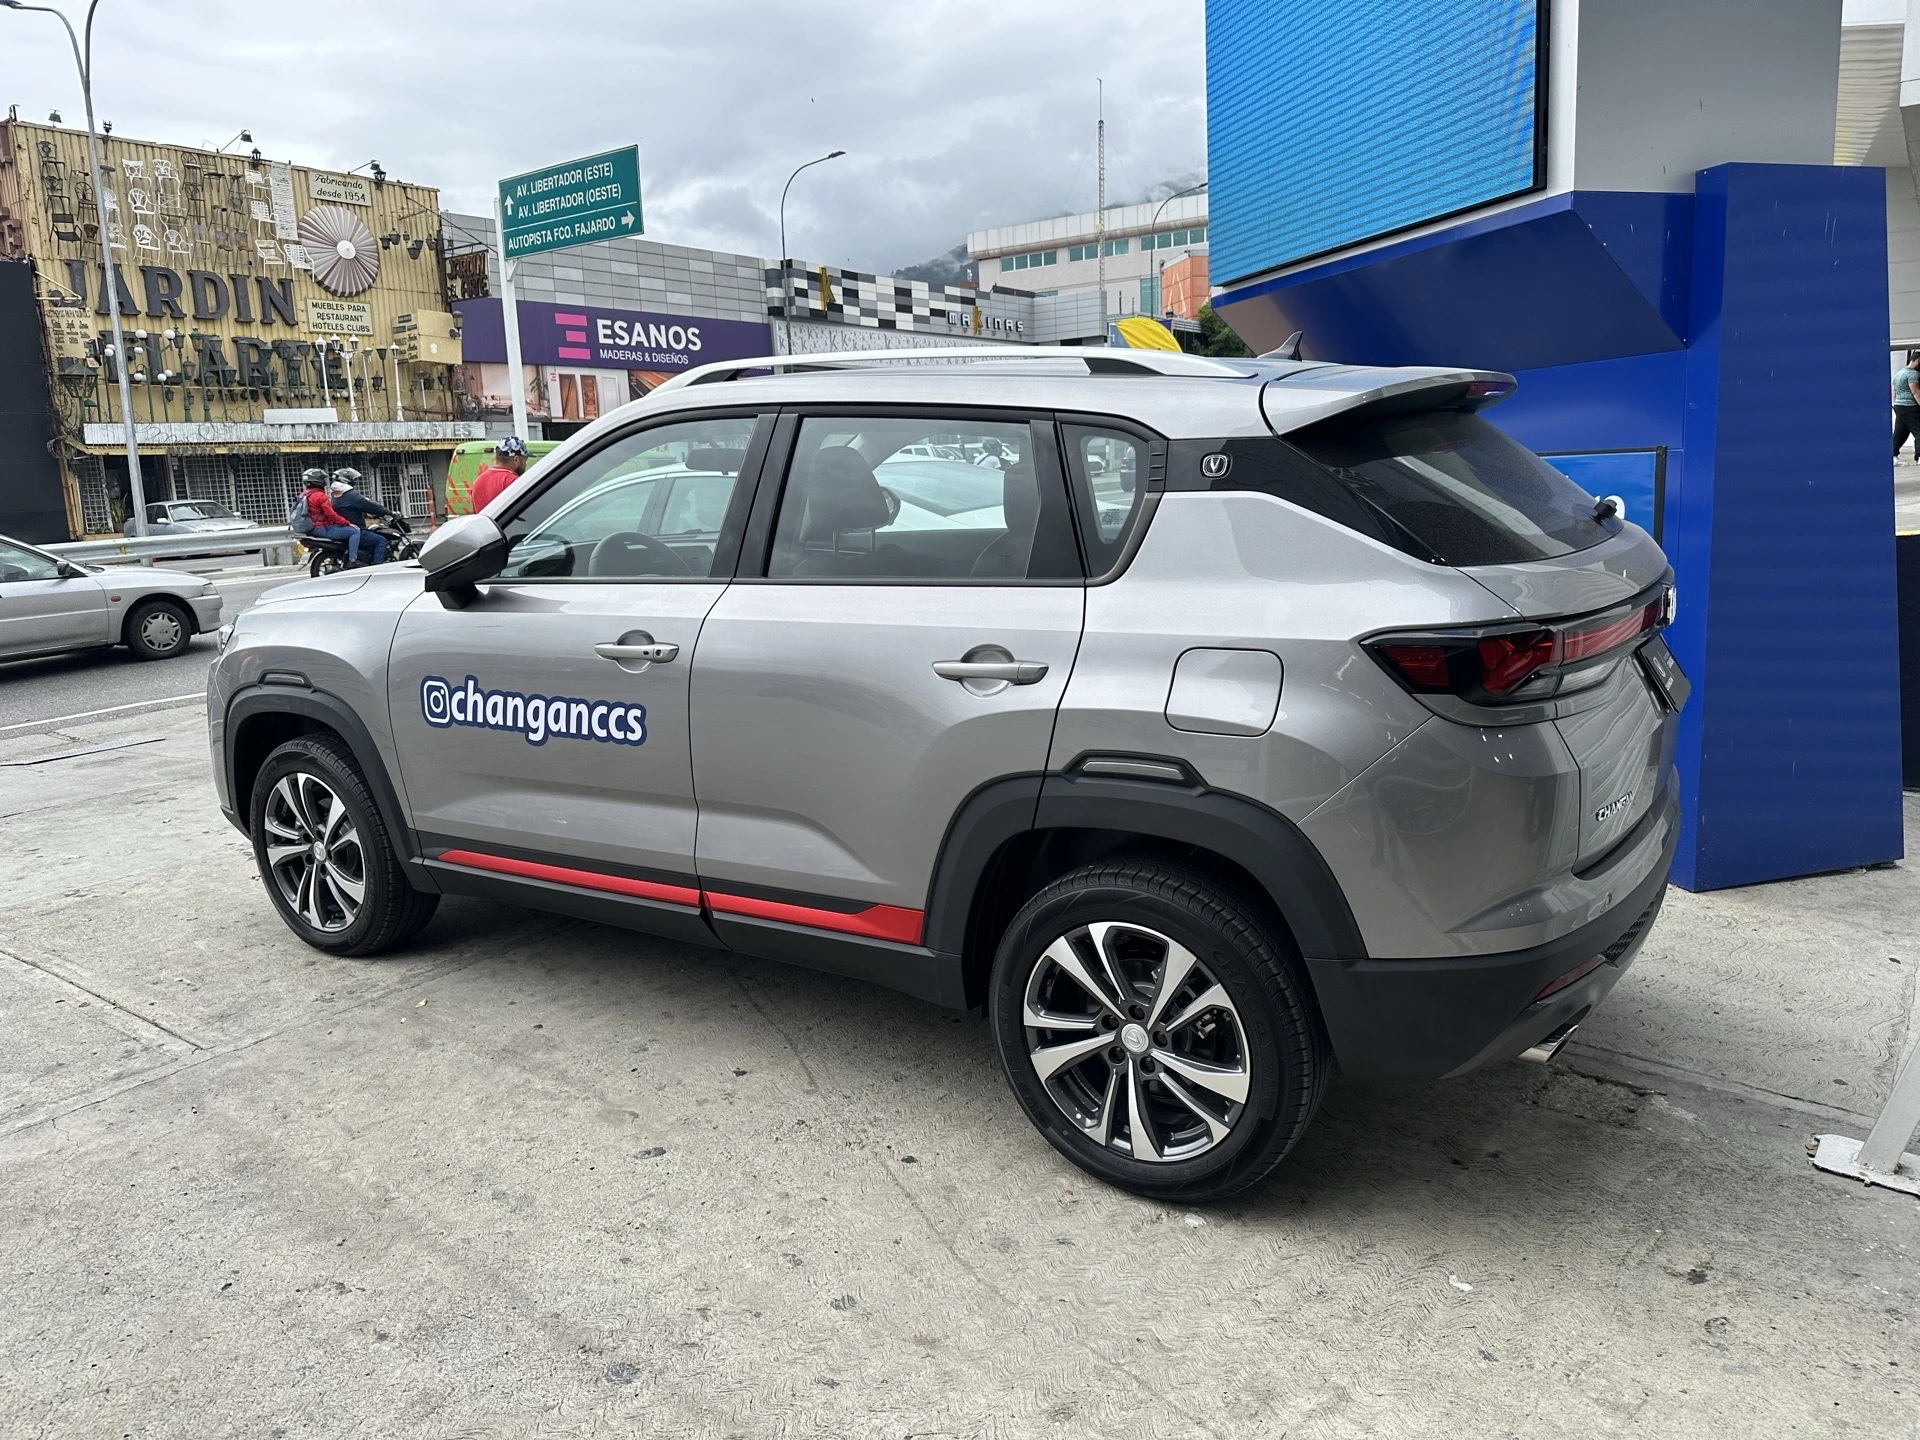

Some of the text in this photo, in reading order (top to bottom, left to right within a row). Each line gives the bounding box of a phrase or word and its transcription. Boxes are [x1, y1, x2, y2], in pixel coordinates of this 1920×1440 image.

[313, 173, 363, 190] Fabricando
[316, 188, 366, 203] desde 1954
[516, 162, 614, 198] AV. LIBERTADOR (ESTE)
[518, 183, 622, 219] AV. LIBERTADOR (OESTE)
[508, 216, 616, 251] AUTOPISTA FCO. FAJARDO
[48, 259, 299, 326] JARDIN
[311, 301, 367, 313] MUEBLES PARA
[312, 321, 370, 333] HOTELES CLUBS
[316, 312, 364, 322] RESTAURANT
[596, 319, 702, 351] ESANOS
[99, 330, 183, 385] EL
[600, 349, 689, 365] MADERAS & DISEÑOS
[450, 678, 645, 743] changanccs
